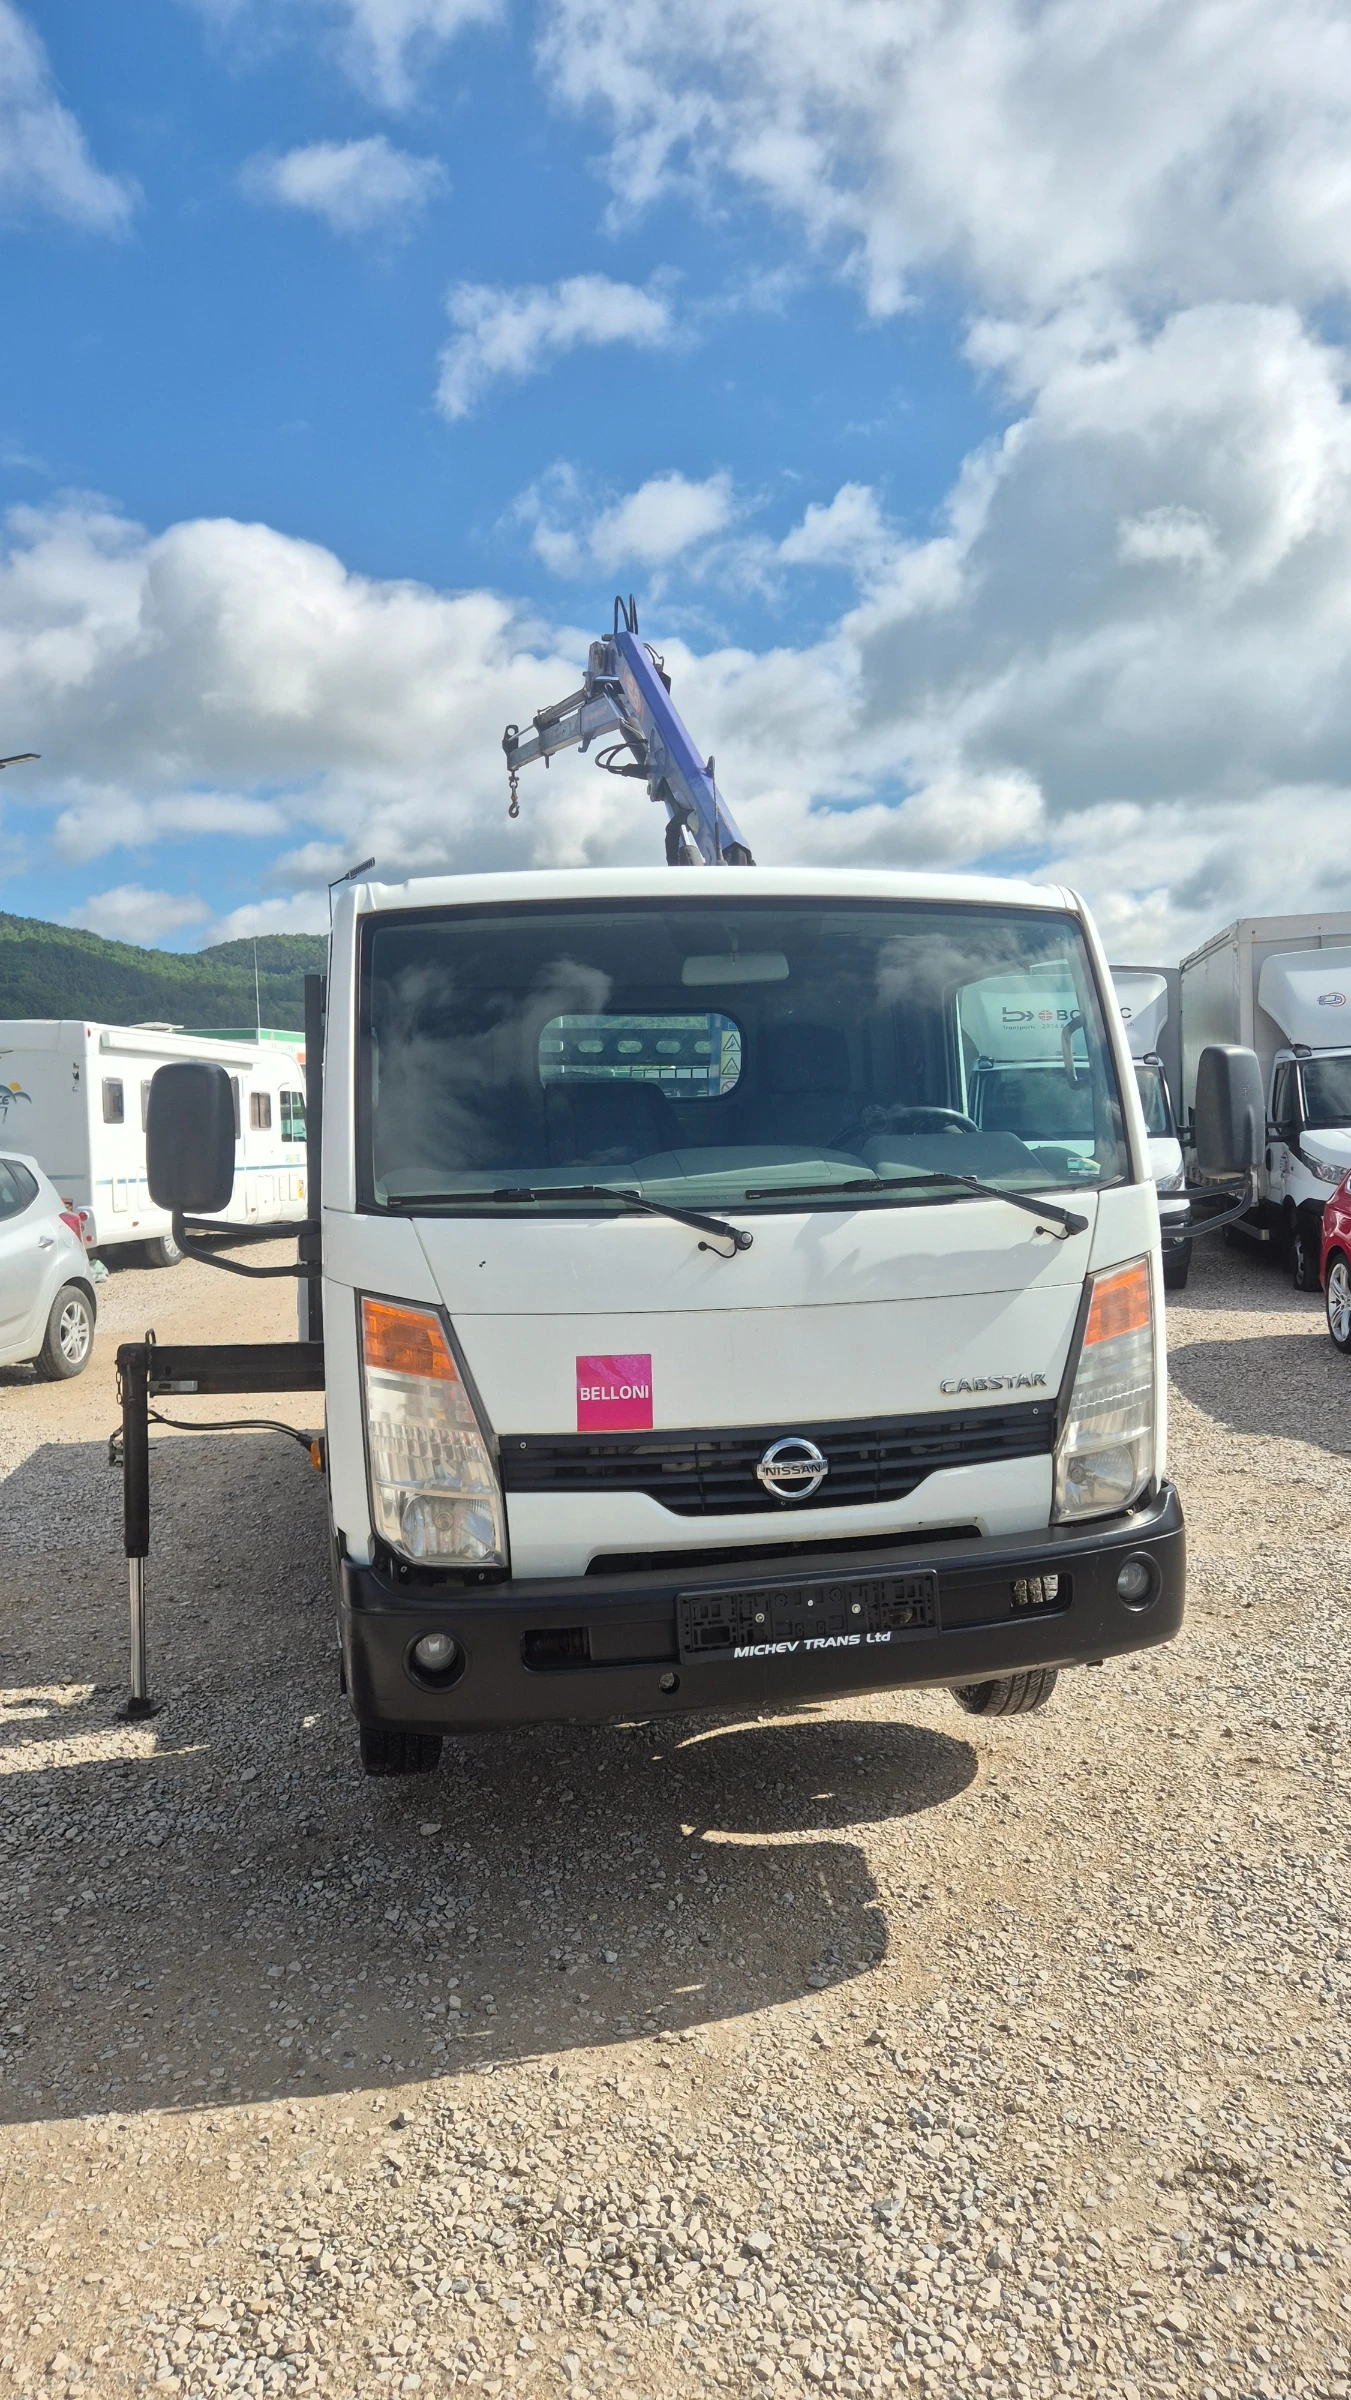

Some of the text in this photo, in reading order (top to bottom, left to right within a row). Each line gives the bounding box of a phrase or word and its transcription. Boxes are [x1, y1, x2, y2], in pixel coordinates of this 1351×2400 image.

[580, 1385, 649, 1401] BELLONI
[940, 1371, 1047, 1395] CABSTAR
[765, 1464, 821, 1476] NISSAN
[733, 1631, 892, 1658] MICHEV TRANS Ltd
